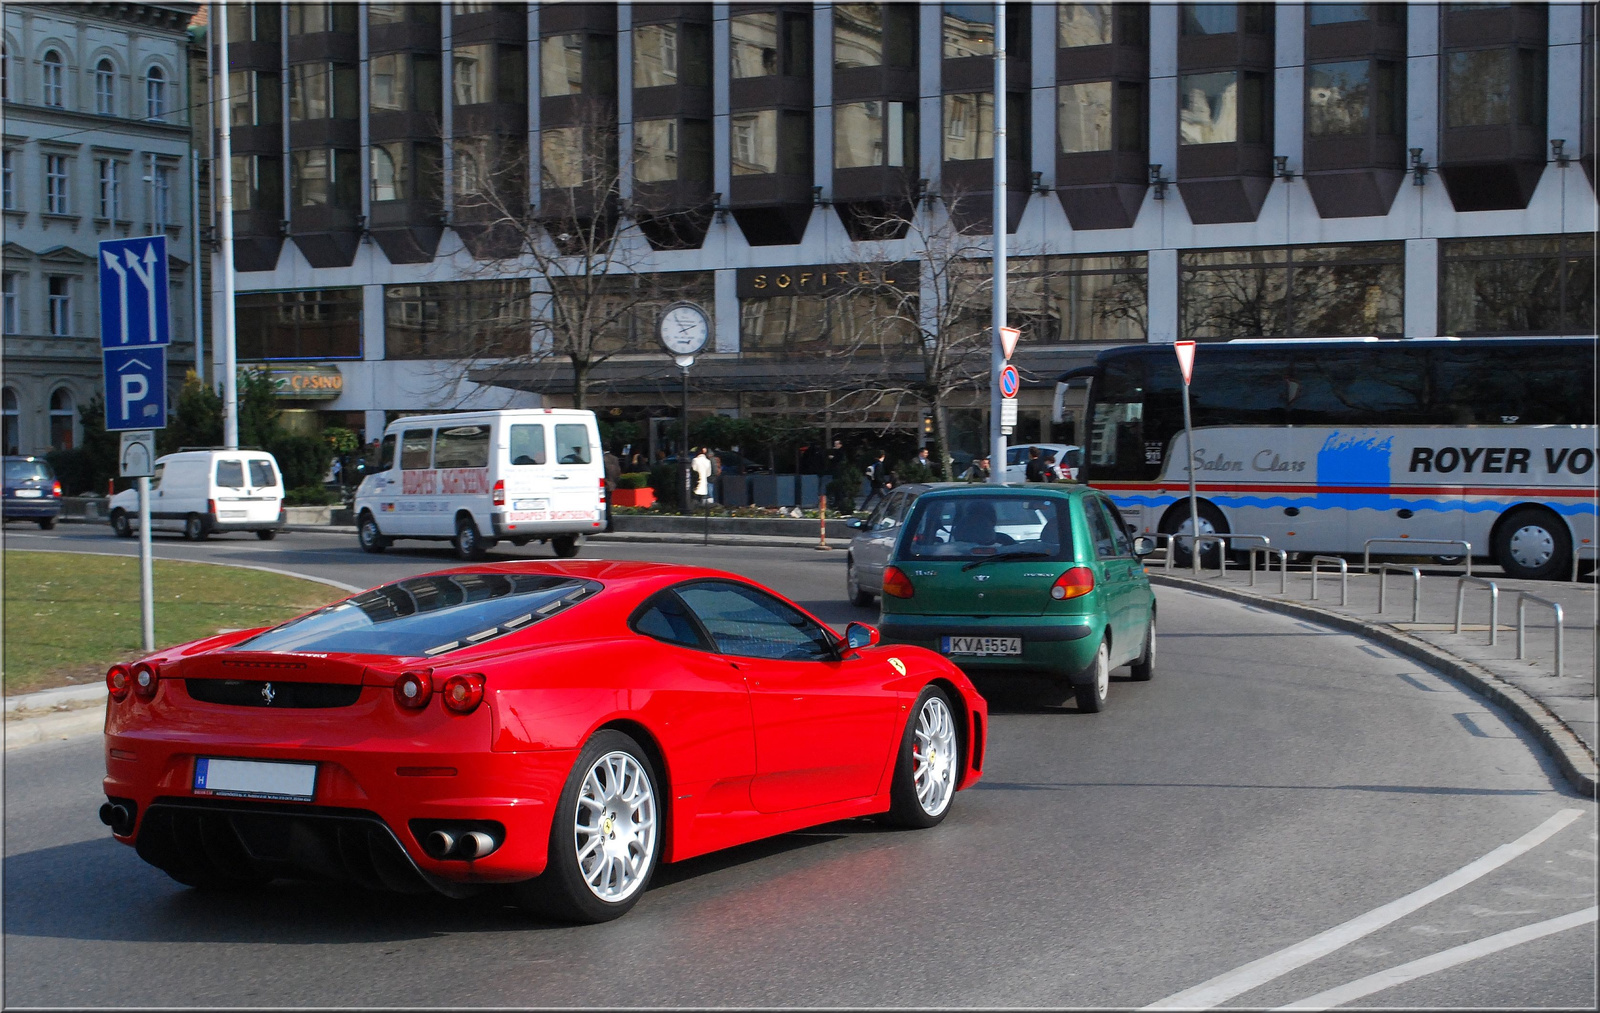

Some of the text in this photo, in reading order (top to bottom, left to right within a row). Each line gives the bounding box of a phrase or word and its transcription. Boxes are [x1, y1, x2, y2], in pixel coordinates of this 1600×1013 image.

[754, 270, 896, 290] SOFITEL
[291, 374, 344, 390] CASINO
[120, 373, 149, 421] P
[1183, 447, 1307, 473] Salon Class
[1409, 446, 1599, 475] ROYER VO
[402, 470, 438, 495] BUDAPEST
[441, 468, 490, 495] SIGHTSEEING
[510, 510, 596, 522] BUDAPEST SIGHTSEEING
[197, 776, 205, 785] H
